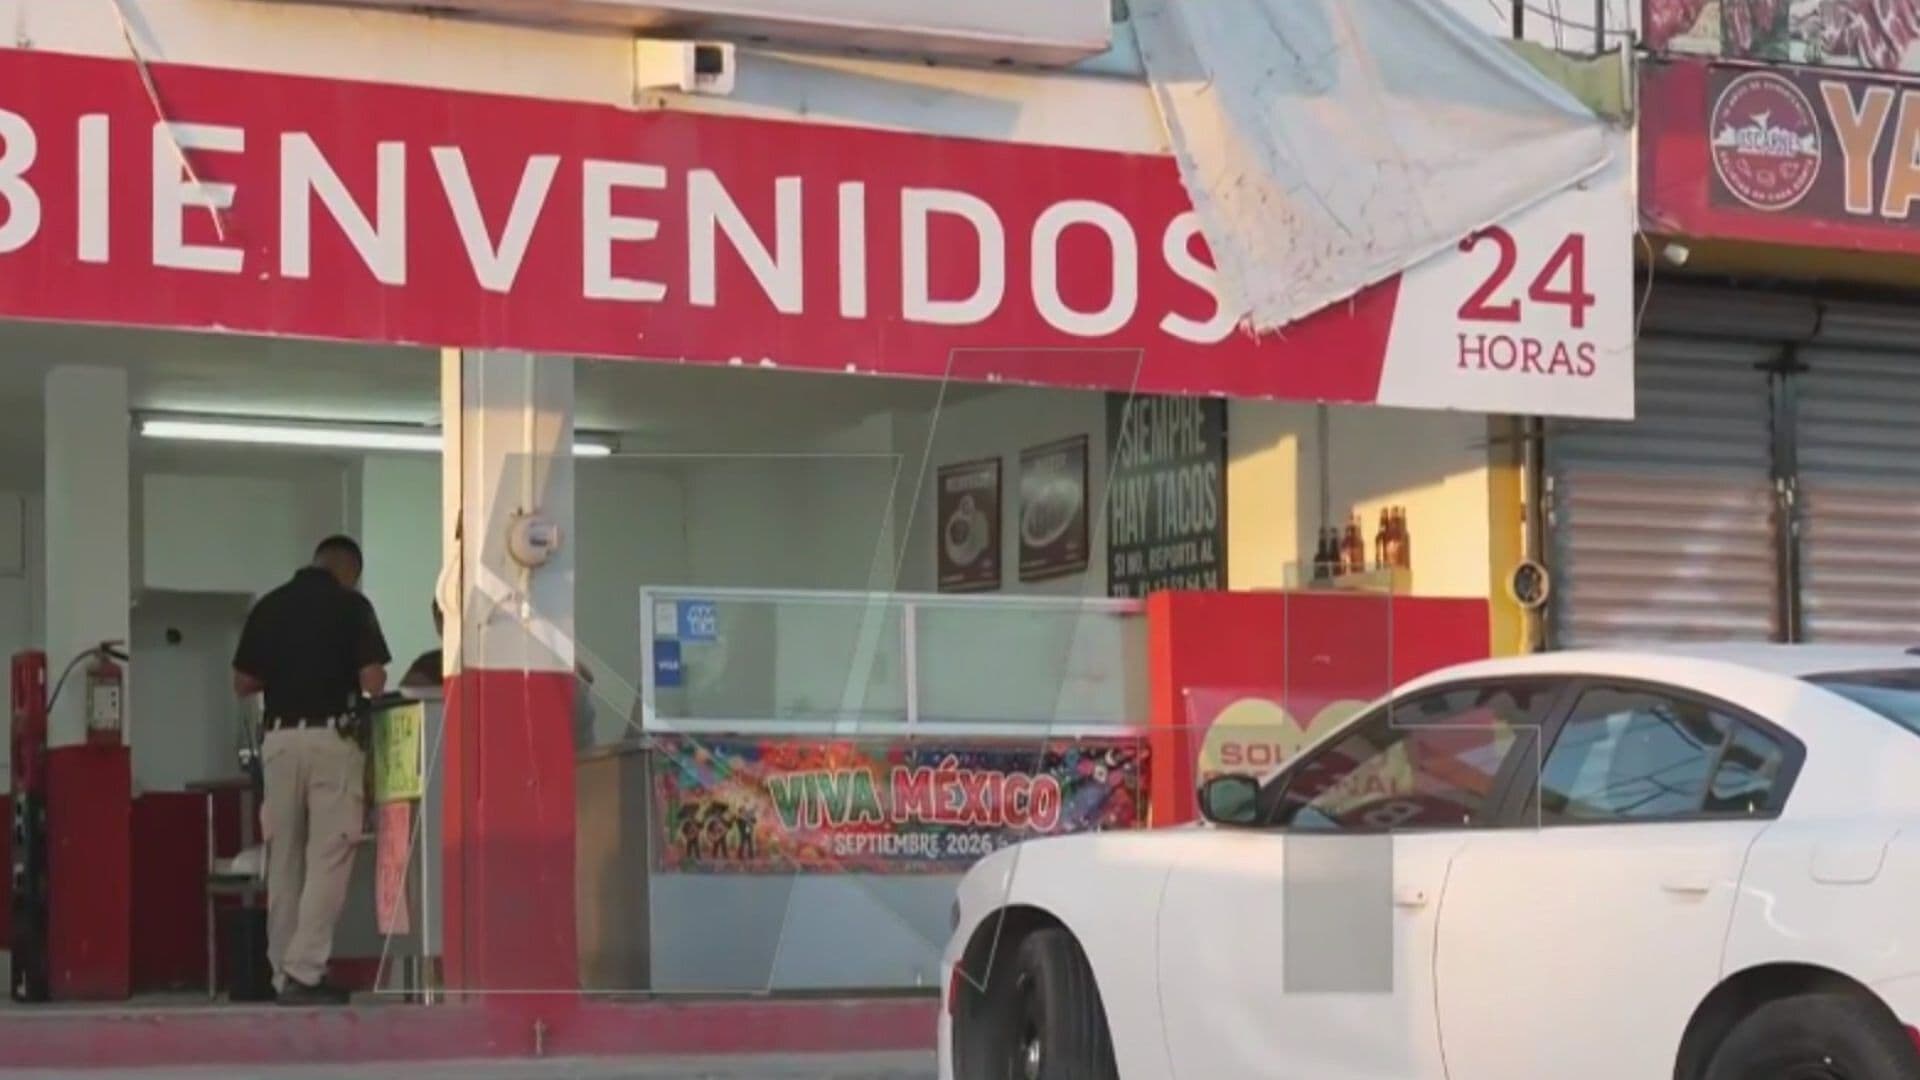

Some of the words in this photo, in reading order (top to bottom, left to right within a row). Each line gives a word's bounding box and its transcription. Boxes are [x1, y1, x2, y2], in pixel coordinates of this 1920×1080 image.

[1457, 224, 1596, 329] 24
[1457, 332, 1596, 377] HORAS
[1120, 394, 1207, 468] SIEMPRE
[1112, 474, 1150, 546] HAY
[1153, 462, 1218, 540] TACOS
[768, 767, 884, 832] VIVA
[890, 754, 1062, 832] MÉXICO
[834, 832, 939, 858] SEPTIEMBRE
[946, 832, 993, 855] 2026
